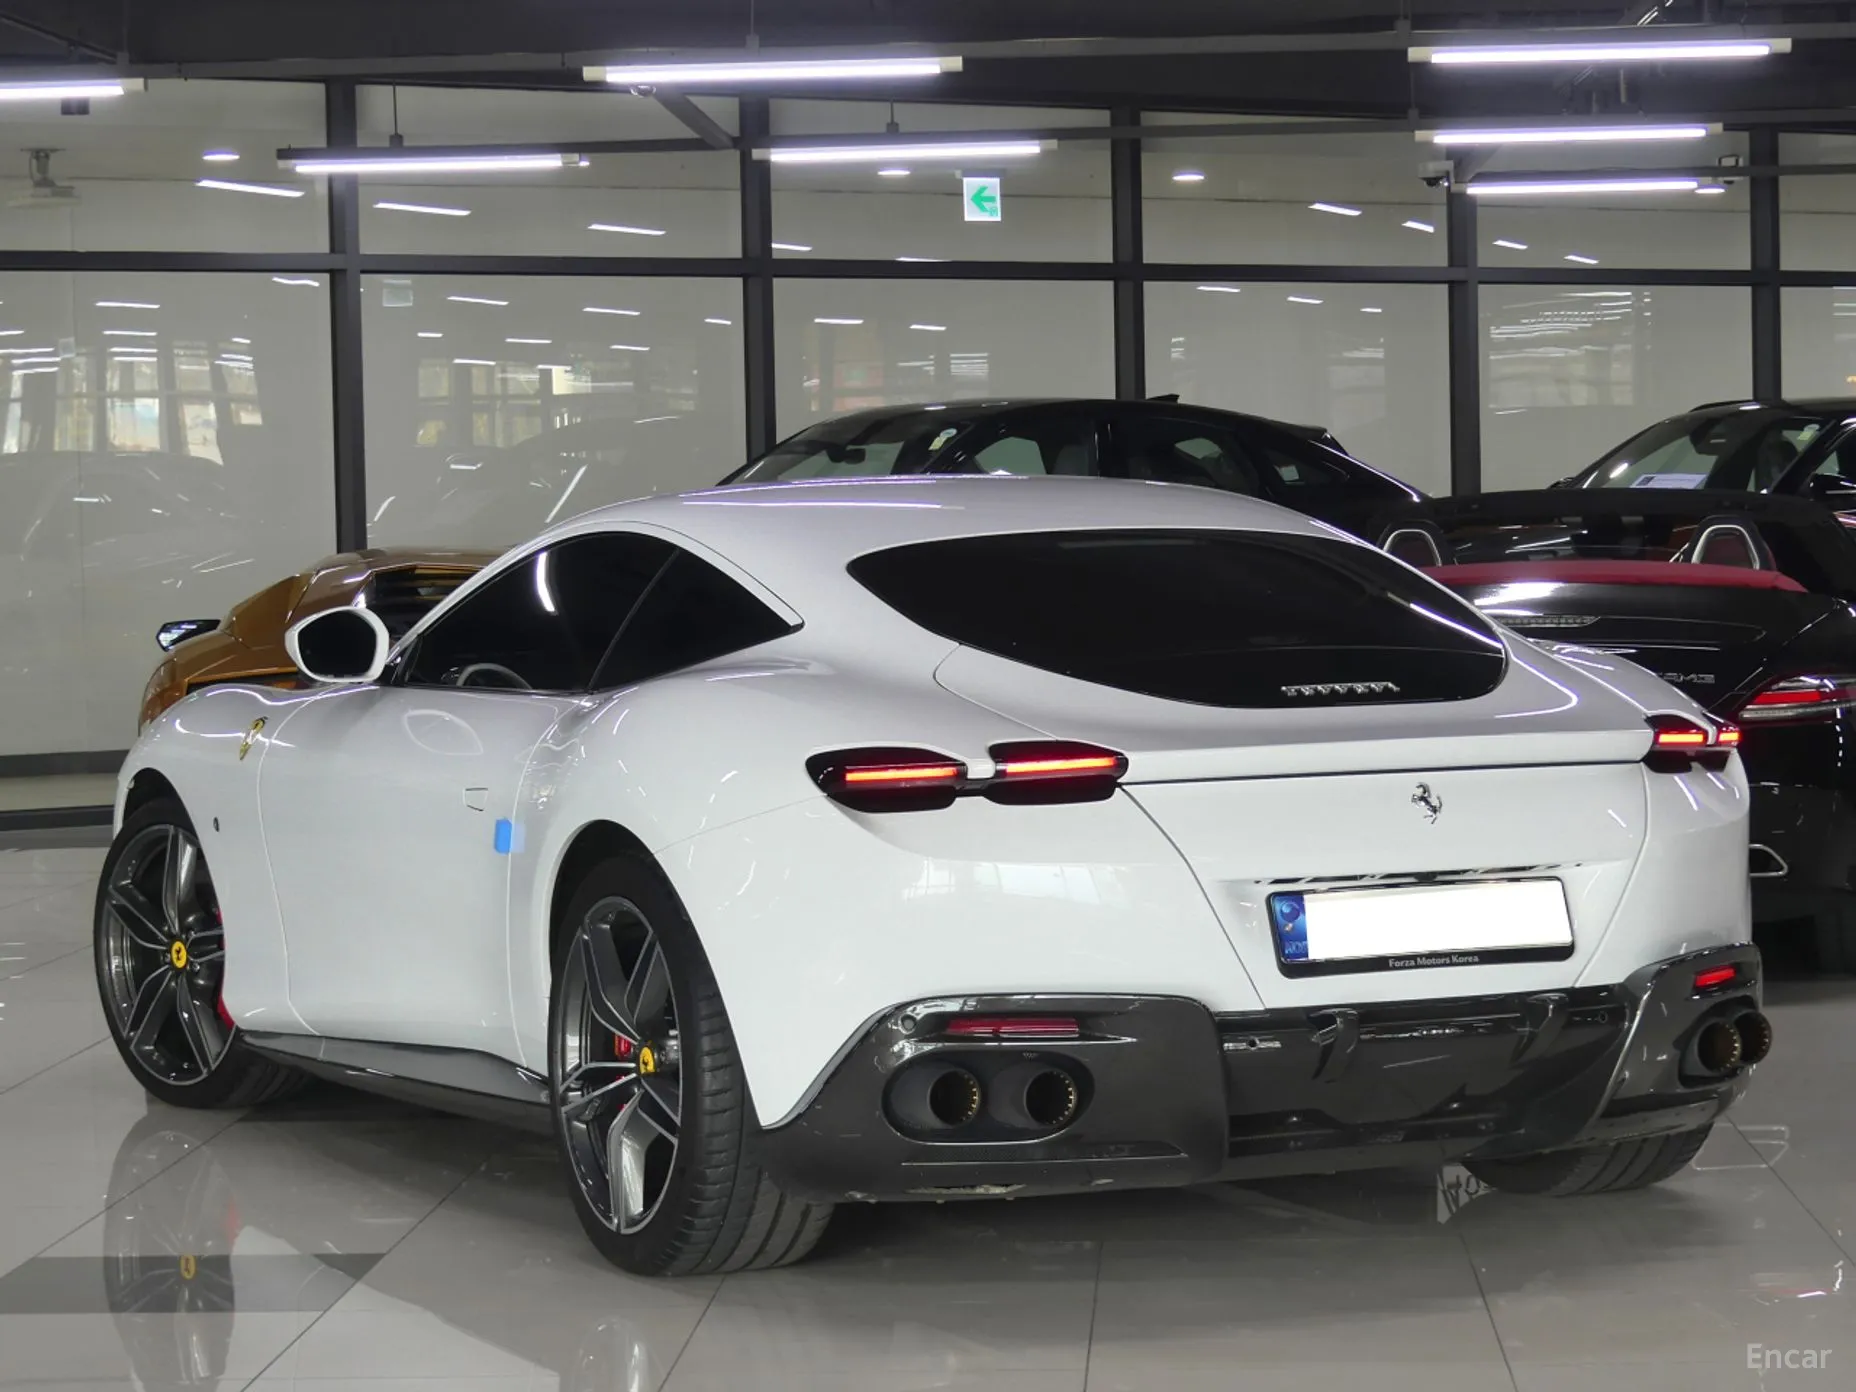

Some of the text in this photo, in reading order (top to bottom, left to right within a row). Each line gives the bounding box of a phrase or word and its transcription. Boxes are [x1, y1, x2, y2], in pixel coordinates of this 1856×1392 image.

[1388, 954, 1479, 968] Forza Motors Korea
